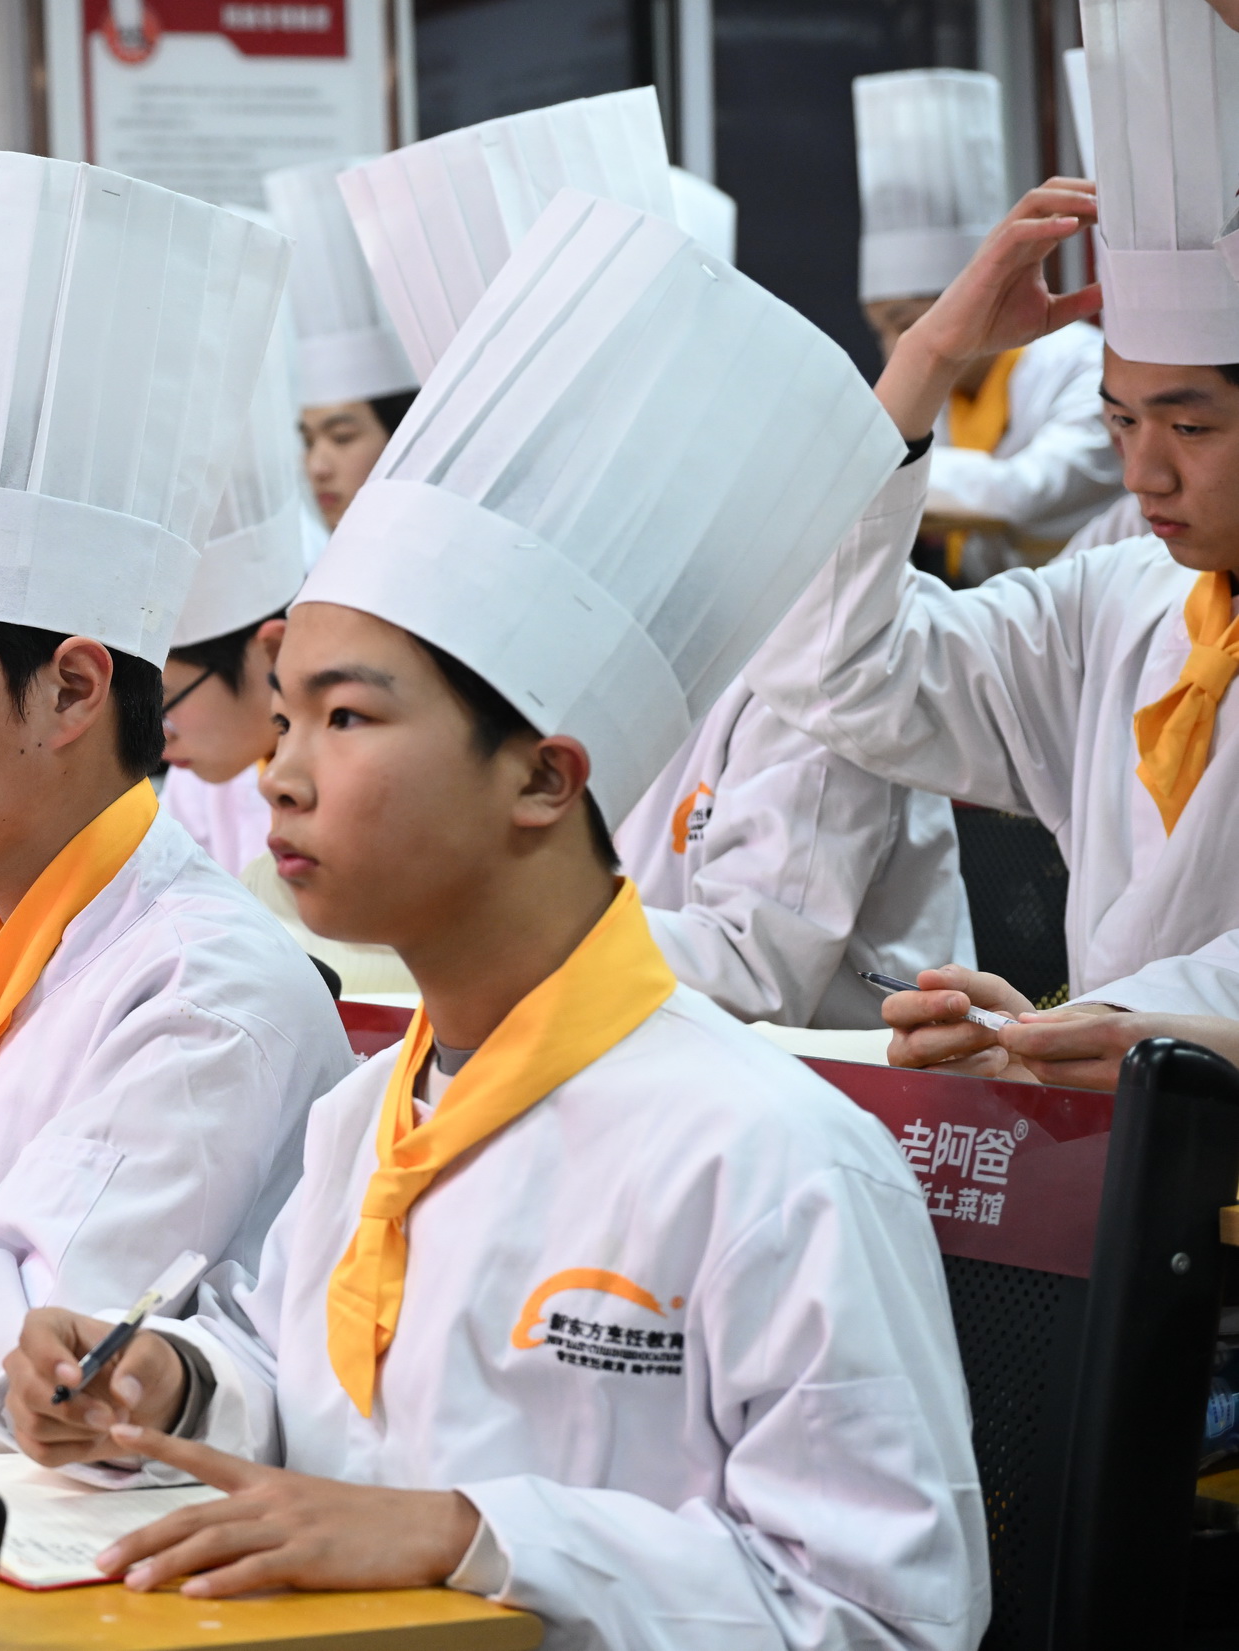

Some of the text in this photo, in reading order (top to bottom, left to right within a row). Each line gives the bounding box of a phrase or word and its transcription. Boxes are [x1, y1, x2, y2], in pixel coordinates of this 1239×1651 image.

[899, 1118, 1016, 1185] 老阿爸
[549, 1312, 685, 1350] 新东方烹饪教育
